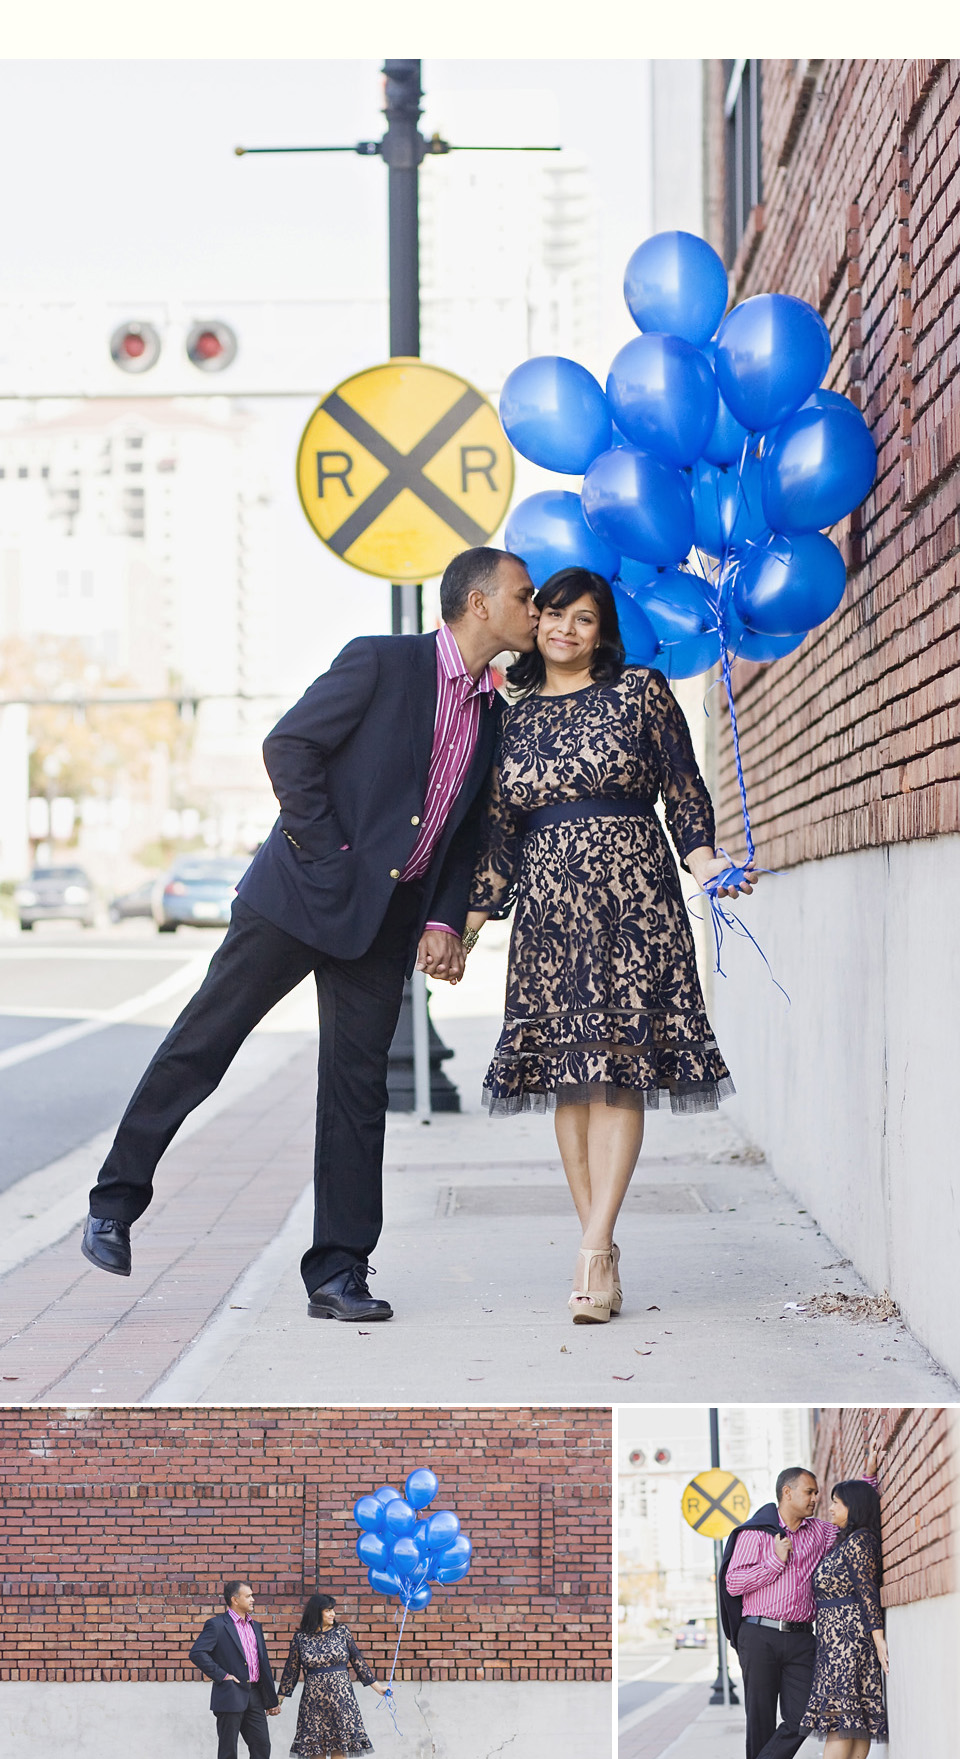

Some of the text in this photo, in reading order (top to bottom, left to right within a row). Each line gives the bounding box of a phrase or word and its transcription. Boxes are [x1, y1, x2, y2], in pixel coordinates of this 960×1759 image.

[315, 446, 498, 498] R R
[687, 1495, 746, 1513] R R
